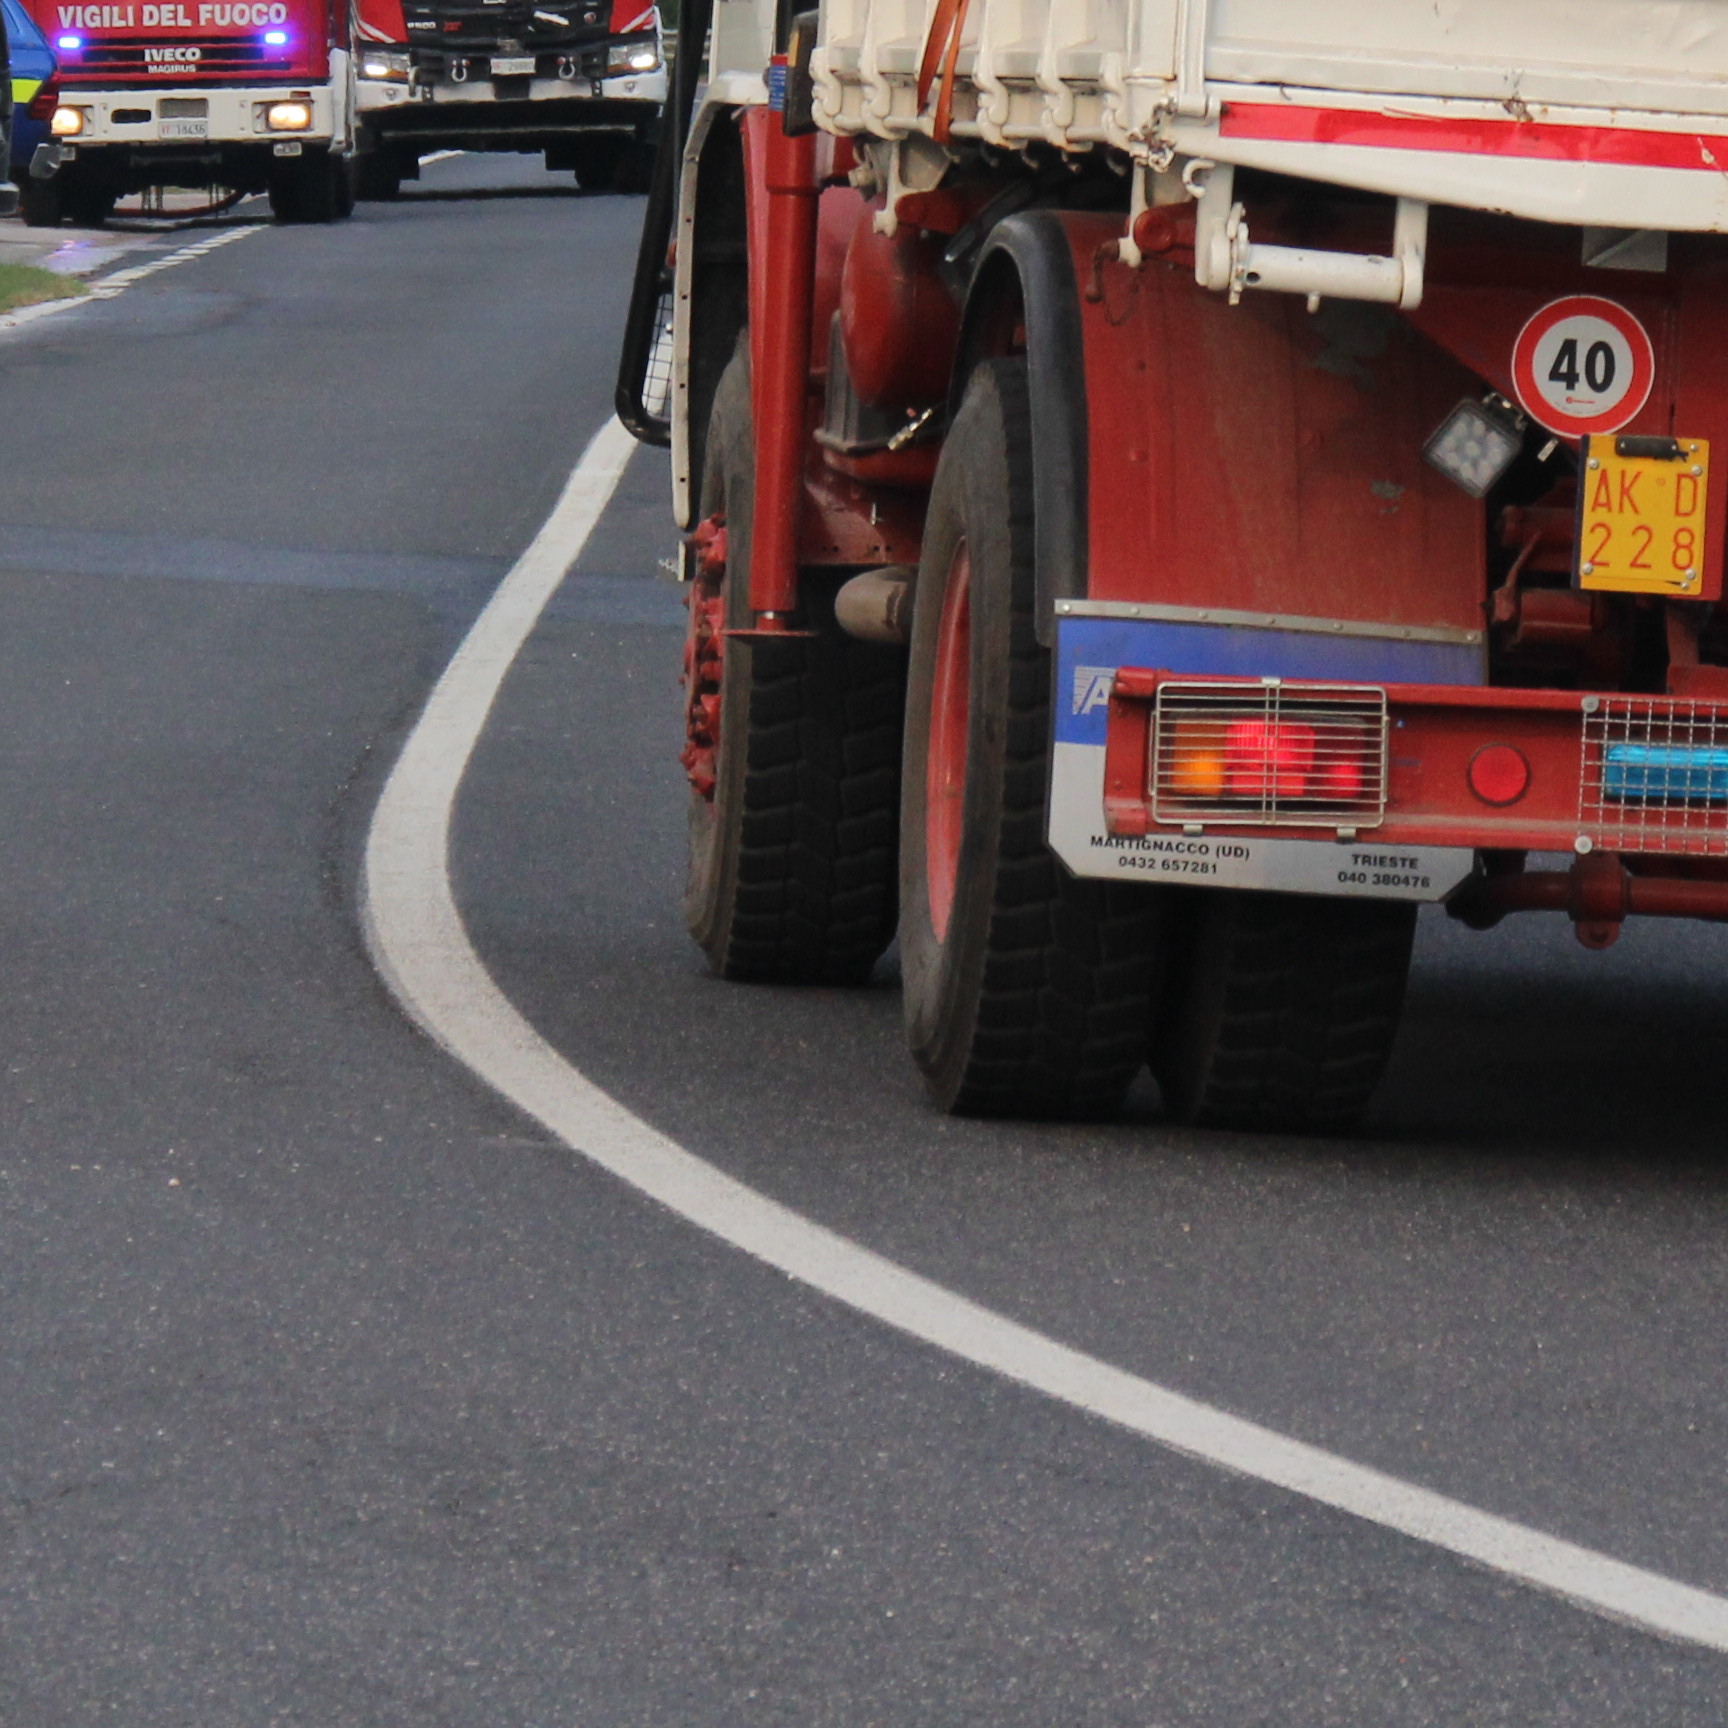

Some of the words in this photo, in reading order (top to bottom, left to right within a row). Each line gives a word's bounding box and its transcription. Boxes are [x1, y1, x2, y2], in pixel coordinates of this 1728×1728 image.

[57, 4, 135, 29] VIGILI
[142, 3, 192, 27] DEL
[198, 2, 288, 27] FUOCO
[144, 47, 202, 63] IVECO
[147, 64, 197, 74] MAGIRUS
[1548, 337, 1616, 394] 40
[1590, 468, 1643, 515] AK
[1673, 472, 1700, 518] D
[1090, 834, 1210, 856] MARTIGNACCO
[1215, 843, 1251, 862] (UD)
[1118, 856, 1156, 870] 0432
[1161, 859, 1219, 875] 657281
[1351, 853, 1419, 870] TRIESTE
[1337, 870, 1368, 885] 040
[1372, 872, 1431, 889] 380476
